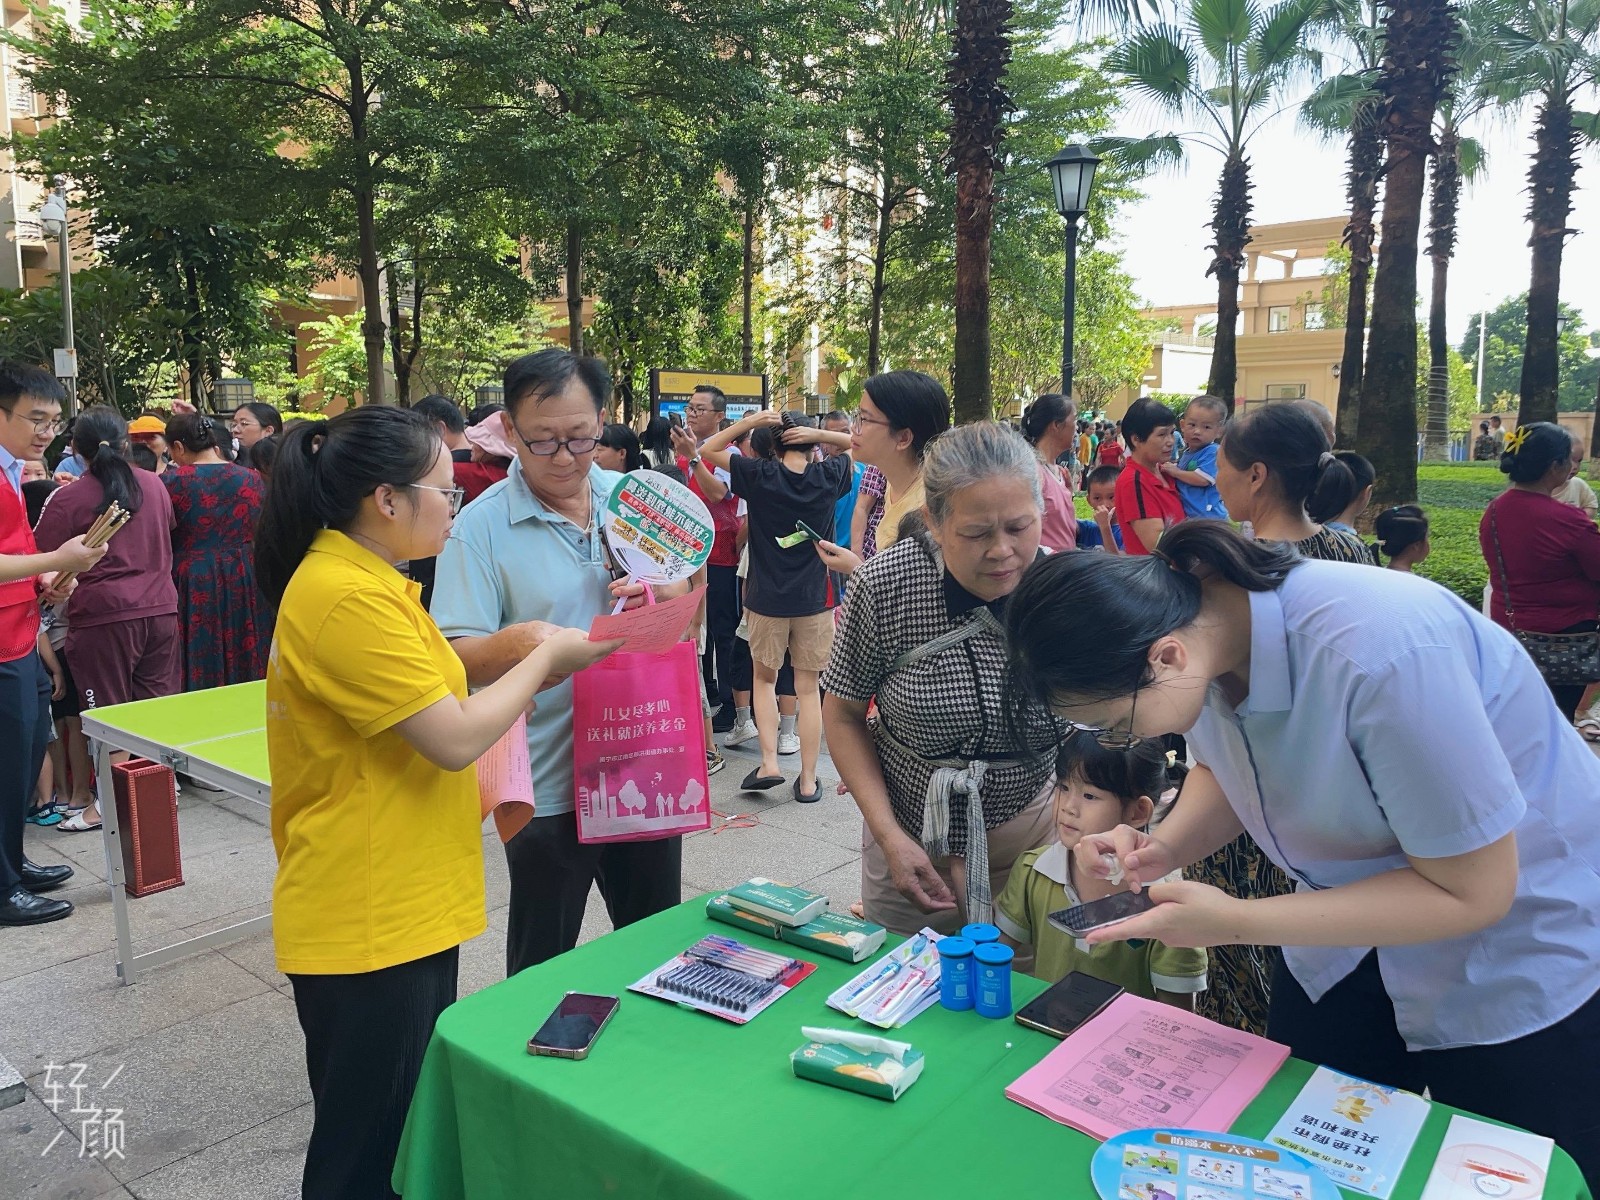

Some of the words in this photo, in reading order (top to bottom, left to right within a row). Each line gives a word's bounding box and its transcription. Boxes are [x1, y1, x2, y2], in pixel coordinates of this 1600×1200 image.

[602, 699, 670, 721] 儿女尽孝心
[586, 717, 687, 742] 送礼就送养老金
[1291, 1126, 1372, 1158] 杜绝假币
[1300, 1114, 1379, 1144] 共建和谐
